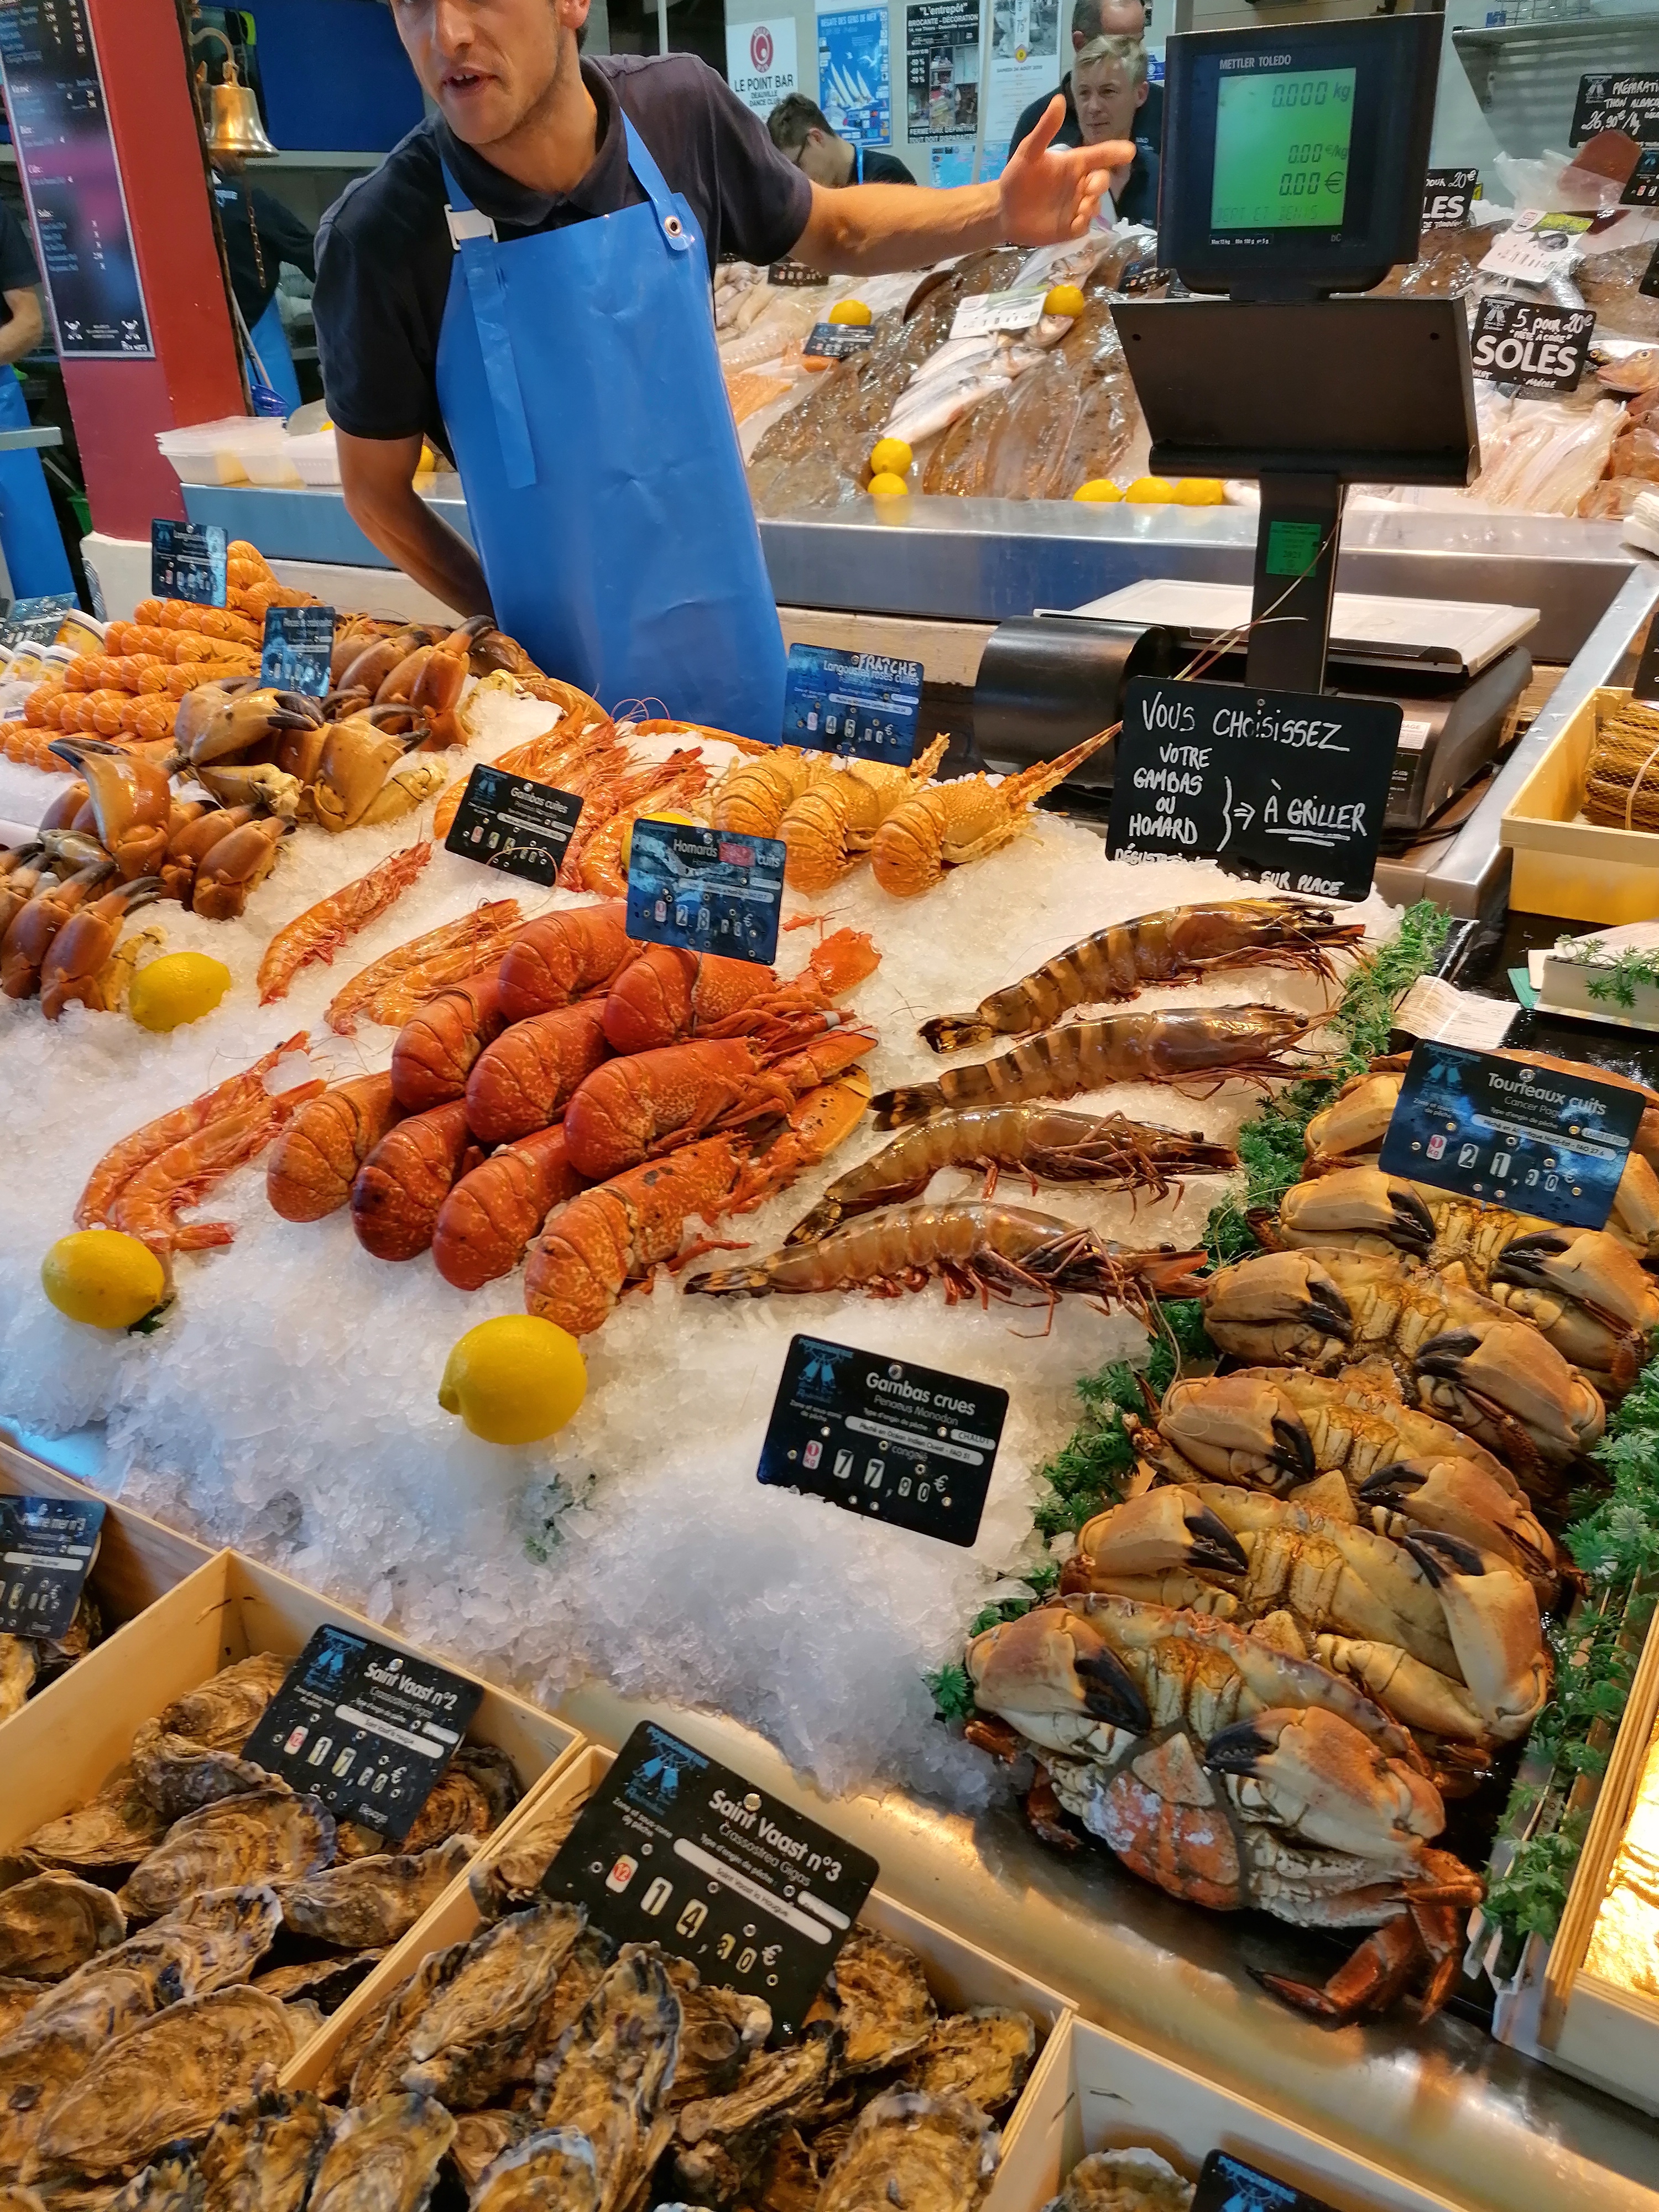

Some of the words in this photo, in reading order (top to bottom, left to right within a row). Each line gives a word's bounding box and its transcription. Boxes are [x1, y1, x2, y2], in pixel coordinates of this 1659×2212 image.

[1219, 58, 1255, 70] METTLER
[1259, 55, 1291, 67] TOLEDO
[734, 79, 745, 92] LE
[748, 76, 773, 90] POINT
[775, 74, 794, 87] BAR
[1333, 83, 1351, 102] kg
[1324, 171, 1344, 194] €
[1512, 308, 1530, 327] 5
[1562, 313, 1594, 333] 20€
[1473, 335, 1578, 377] SOLES
[1142, 691, 1195, 732] VOUS
[1160, 743, 1213, 771] VOTRE
[1133, 767, 1203, 796] GAMBAS
[1155, 796, 1176, 815] OU
[1264, 779, 1282, 824] À
[1287, 795, 1368, 837] GRILLER
[1129, 813, 1198, 845] HOMARD
[672, 839, 718, 857] Homards
[1260, 870, 1290, 891] SUR
[1297, 874, 1345, 896] PLACE
[1486, 1072, 1567, 1105] Tourteaux
[1568, 1092, 1608, 1116] cuits
[1504, 1096, 1538, 1111] Cancer
[1428, 1149, 1439, 1158] kg
[864, 1370, 932, 1403] Gambas
[933, 1393, 976, 1415] crues
[873, 1395, 914, 1413] Penaeus
[914, 1406, 959, 1426] Monodon
[805, 1457, 816, 1467] kg
[949, 1448, 962, 1457] FAO
[363, 1660, 400, 1688] Saint
[397, 1674, 436, 1702] Vaast
[431, 1688, 458, 1712] n°2
[706, 1787, 760, 1830] Saint
[752, 1816, 811, 1863] Vaast
[805, 1848, 845, 1884] n°3
[776, 1860, 813, 1890] Gigas
